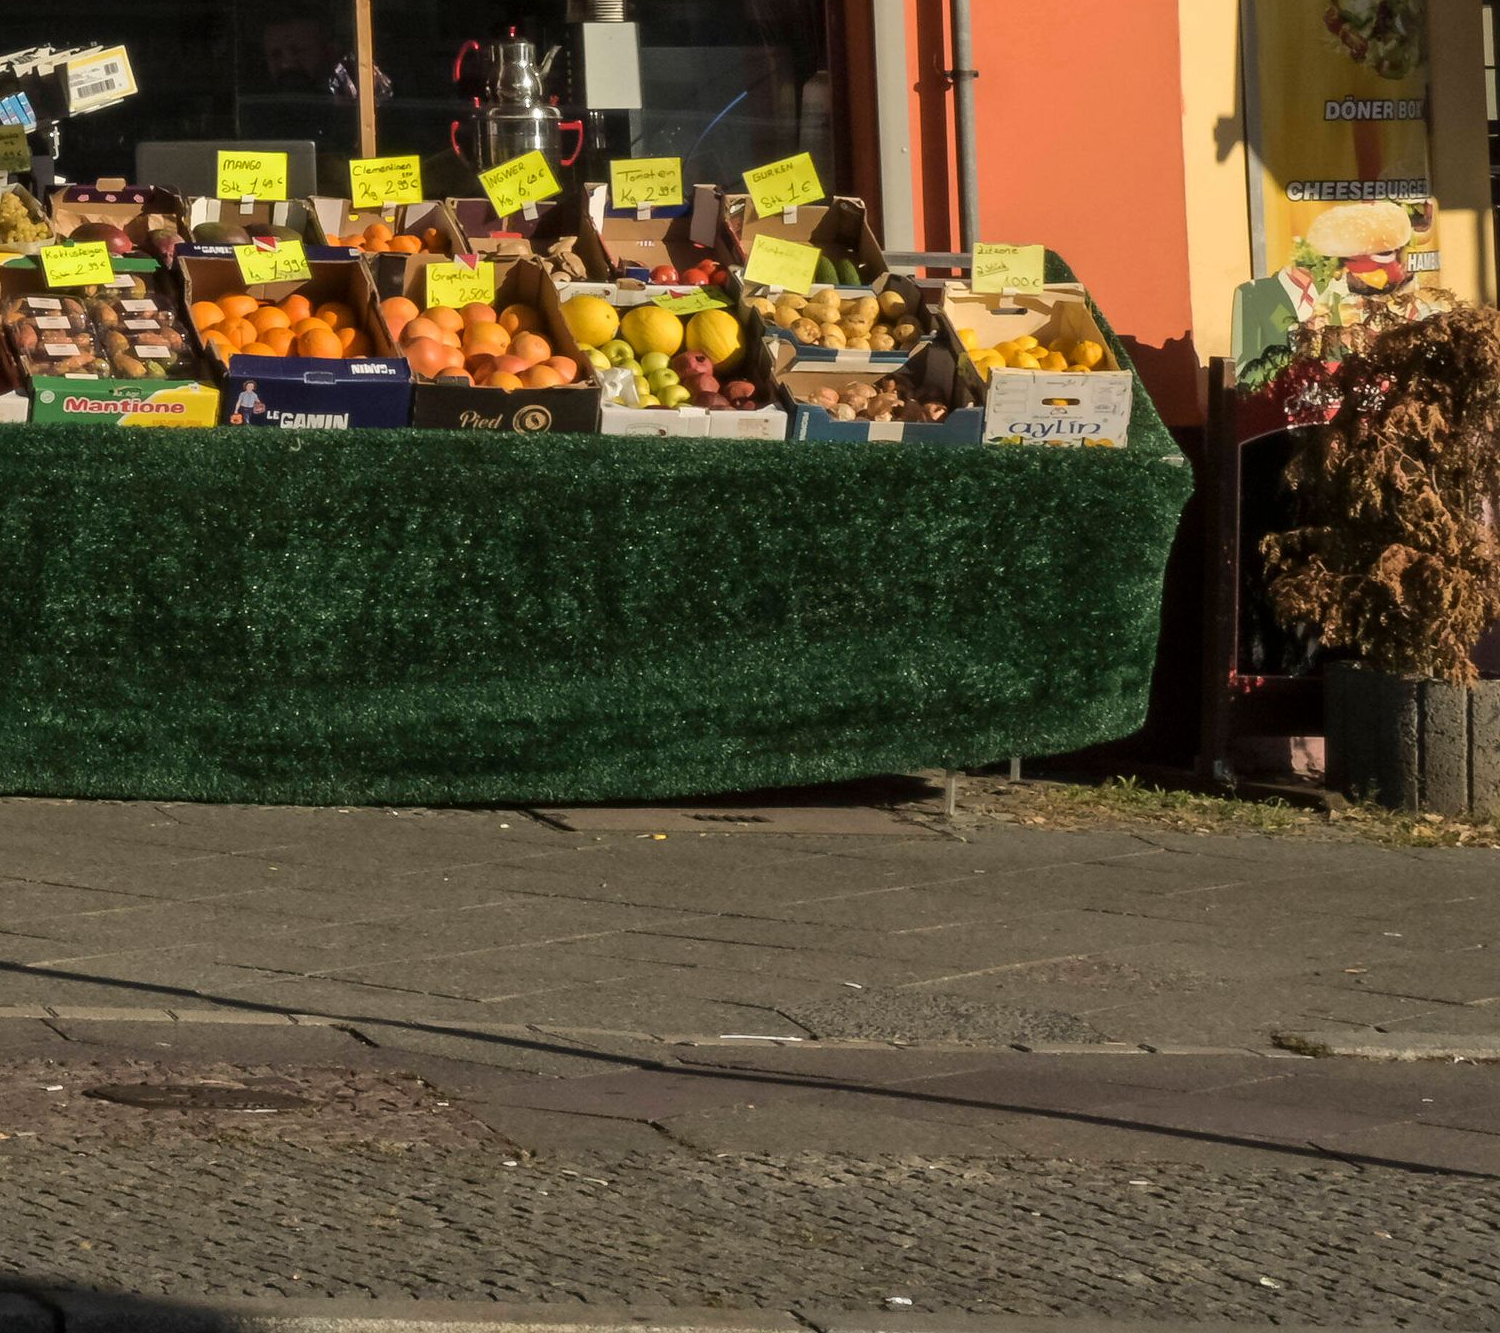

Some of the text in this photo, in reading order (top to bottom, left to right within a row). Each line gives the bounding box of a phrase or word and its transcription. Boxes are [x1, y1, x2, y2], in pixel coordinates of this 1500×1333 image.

[1324, 95, 1395, 121] DÖNER
[223, 159, 262, 171] MANGO
[352, 162, 412, 177] Clementinen
[486, 161, 526, 189] INGWER
[64, 397, 186, 414] Mantione
[267, 409, 349, 430] LE GAMIN
[1008, 419, 1102, 439] aylin
